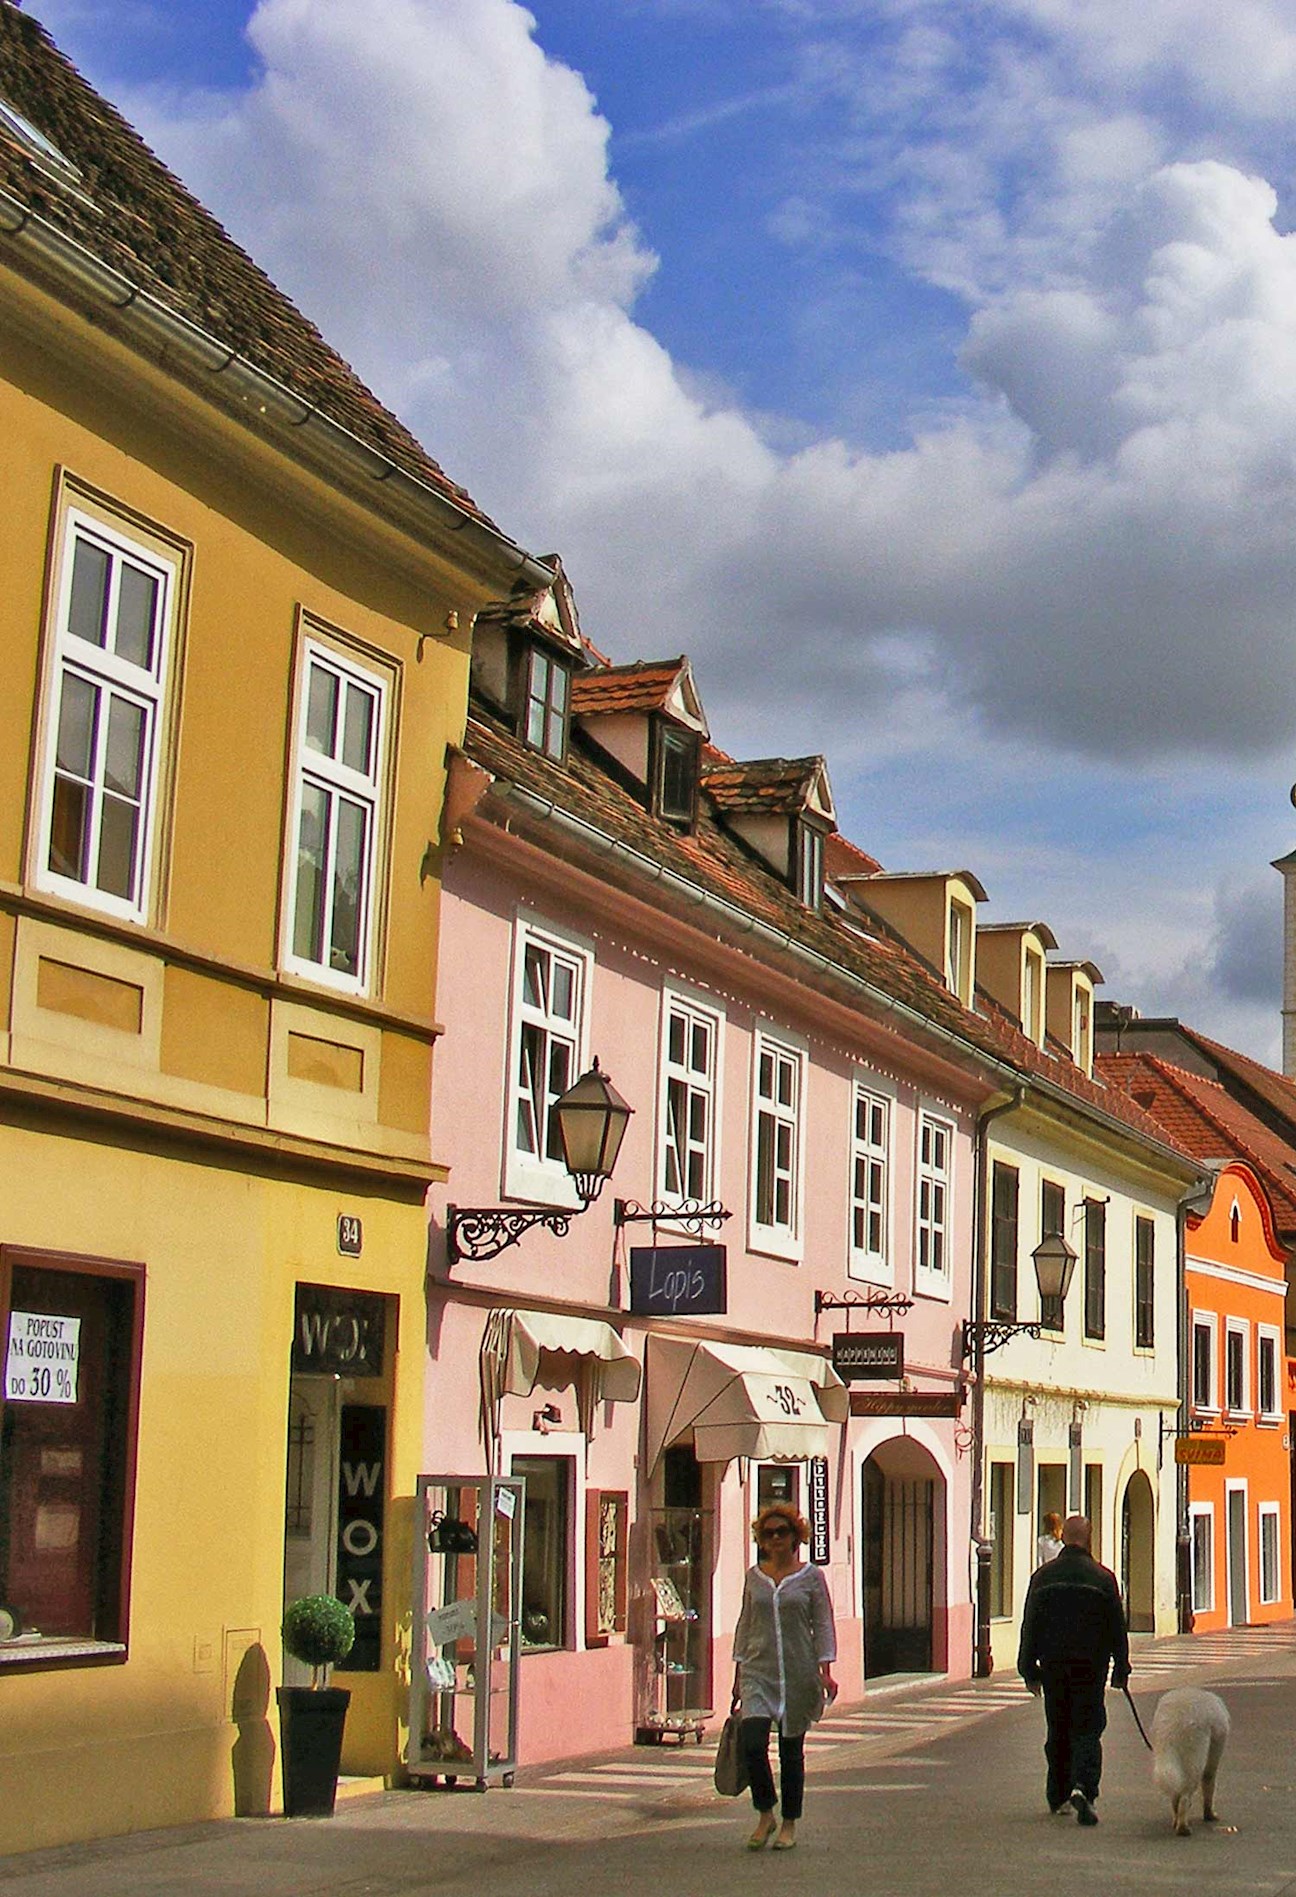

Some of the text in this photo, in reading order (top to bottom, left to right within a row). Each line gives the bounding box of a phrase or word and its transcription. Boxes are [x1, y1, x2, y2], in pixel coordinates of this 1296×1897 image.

[343, 1218, 358, 1243] 34
[648, 1251, 705, 1311] Lapis
[27, 1319, 65, 1338] POPUST
[11, 1338, 76, 1360] NA GOTOVINU
[12, 1367, 71, 1398] DO 30 %
[775, 1385, 801, 1415] 32
[342, 1462, 381, 1614] WOX
